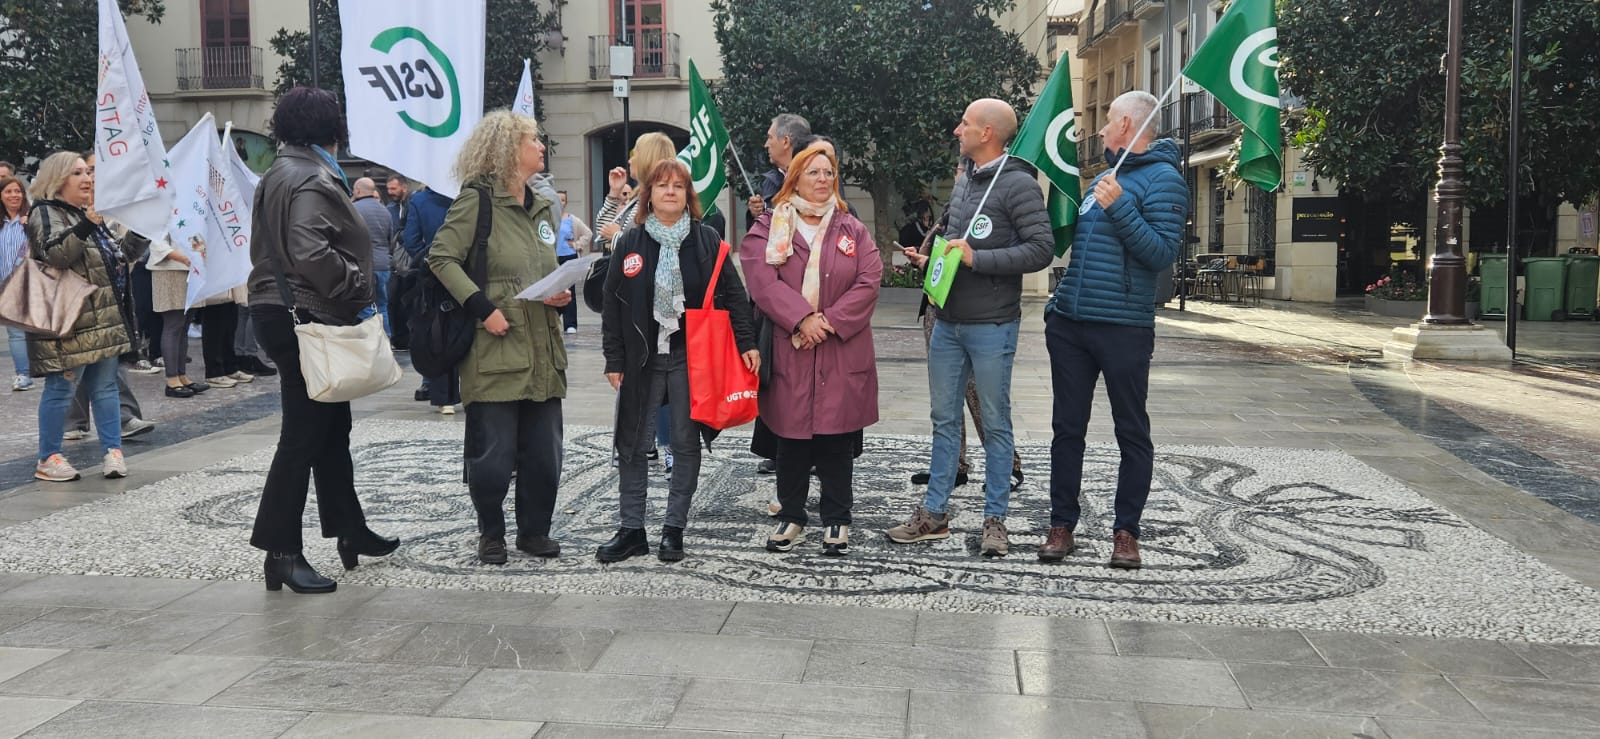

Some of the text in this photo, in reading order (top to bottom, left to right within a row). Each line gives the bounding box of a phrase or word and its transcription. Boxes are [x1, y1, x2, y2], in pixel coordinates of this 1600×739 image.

[98, 92, 128, 157] SITAG
[218, 200, 248, 247] SITAG
[726, 391, 743, 403] UGT
